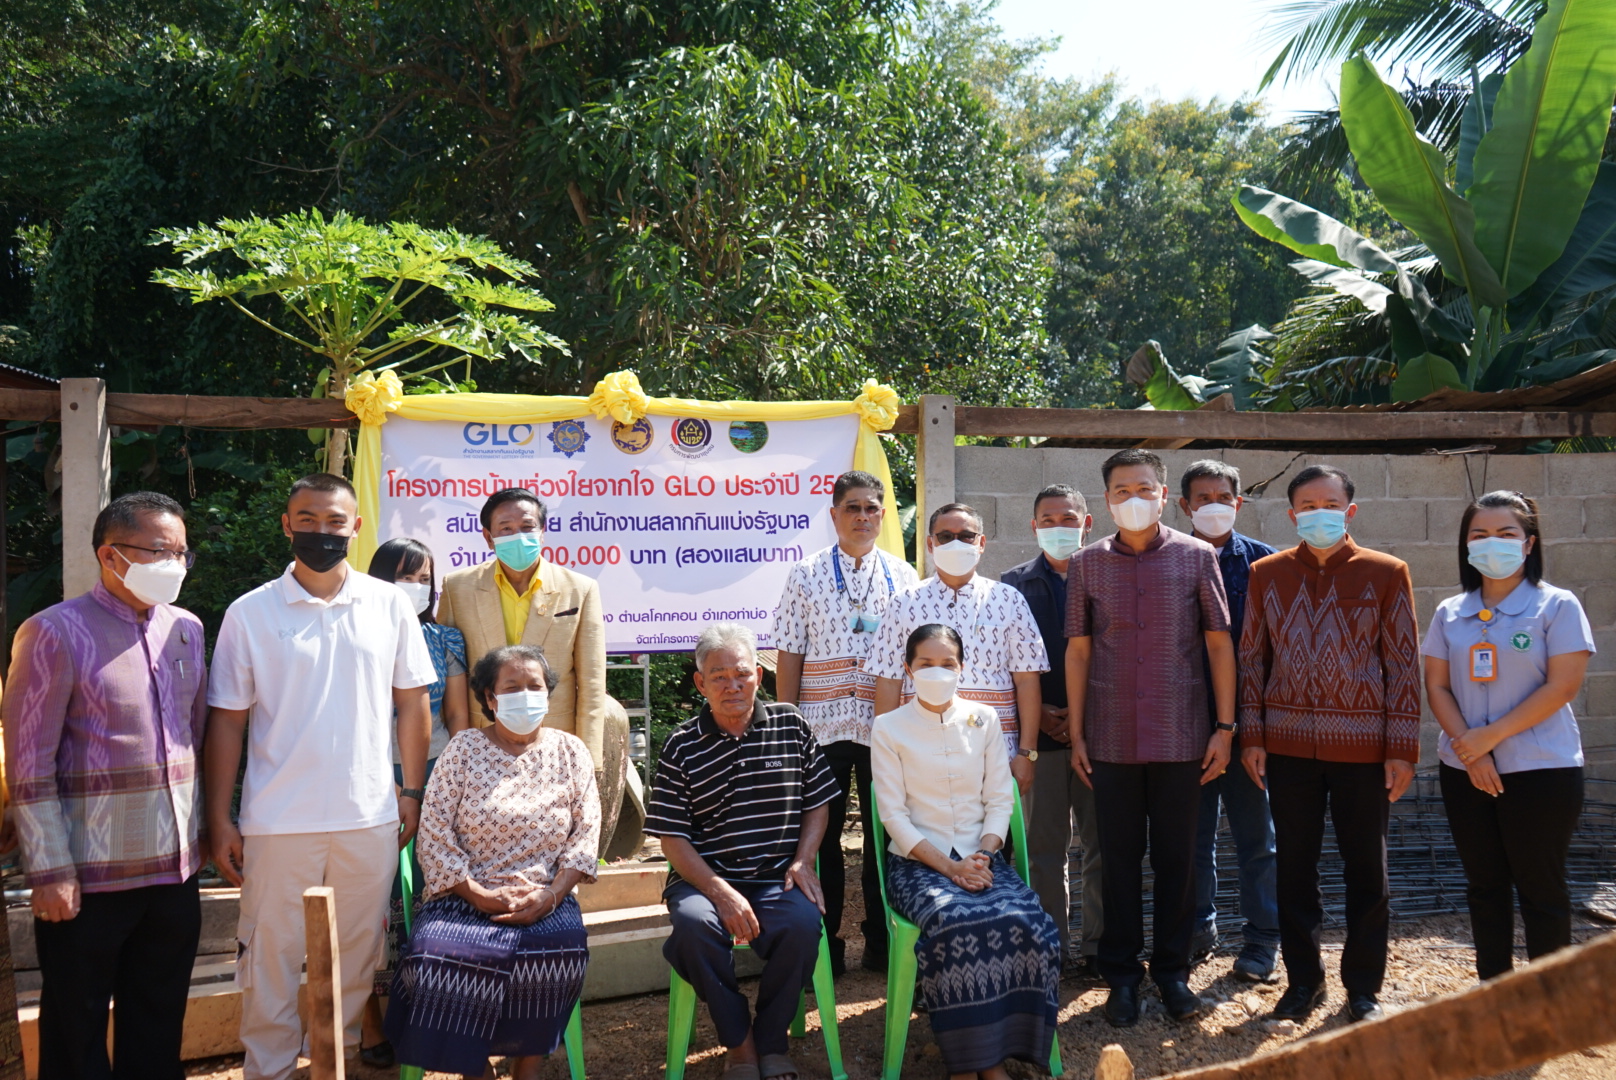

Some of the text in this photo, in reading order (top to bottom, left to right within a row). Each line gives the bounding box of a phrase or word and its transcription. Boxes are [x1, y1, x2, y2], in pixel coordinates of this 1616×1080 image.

[463, 421, 534, 446] GLO
[462, 448, 535, 456] สำนักงานสลากกินแบ่งรัฐบาล
[668, 443, 715, 460] กรมการพัฒนาชุมชน
[664, 475, 716, 497] GLO
[725, 472, 800, 497] ประจำปี
[809, 474, 843, 495] 25
[569, 510, 810, 535] สำนักงานสลากกินแบ่งรัฐบาล
[630, 548, 666, 564] บาท
[675, 544, 804, 568] (สองแสนบาท)
[618, 608, 698, 623] ตำบลโคกคอน
[702, 607, 768, 621] อำเภอท่าบ่อ
